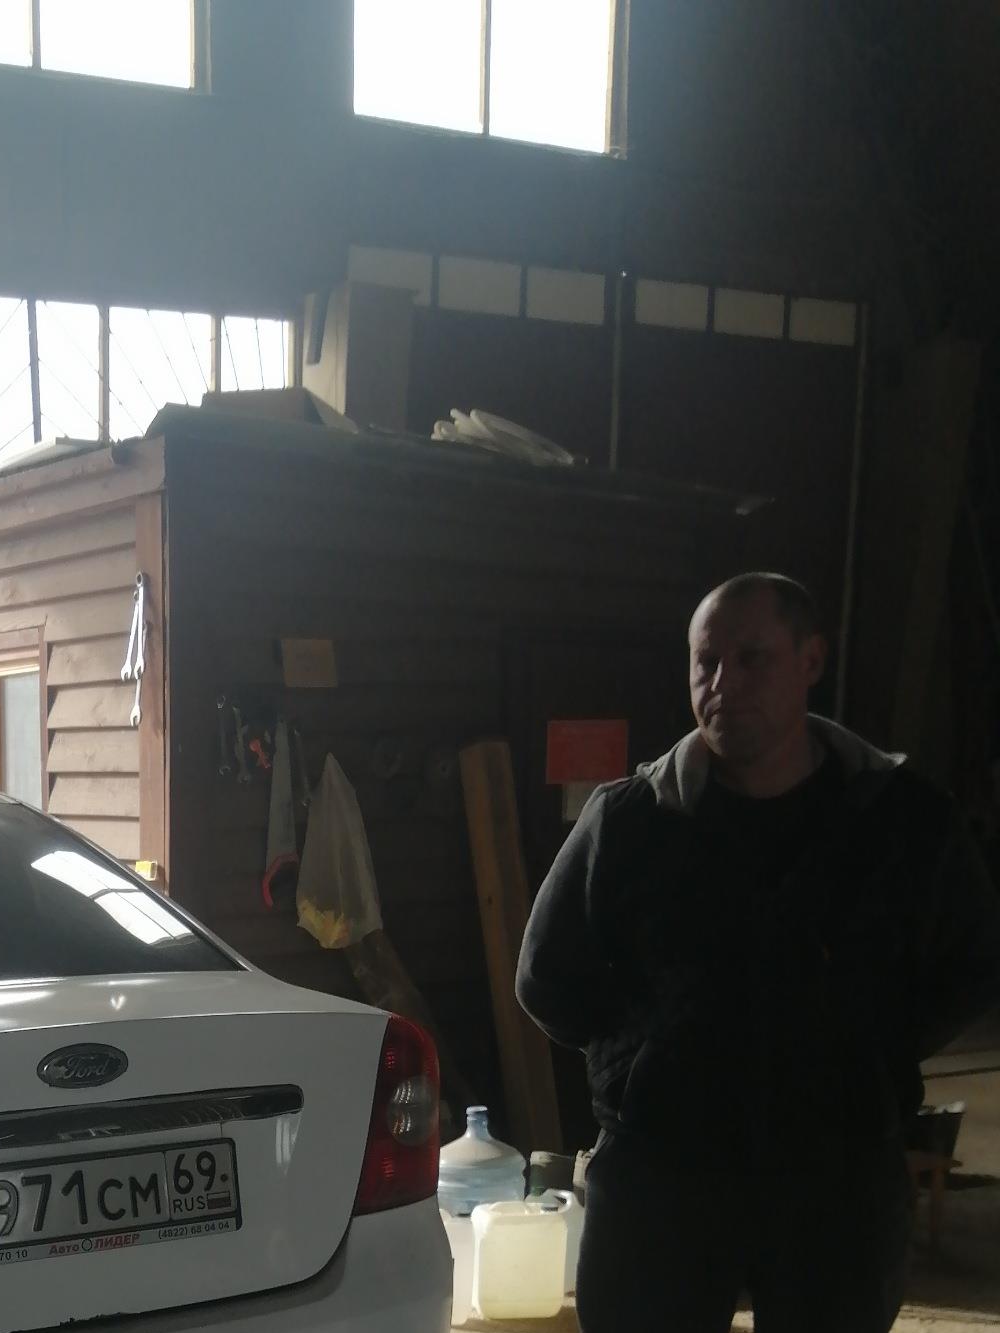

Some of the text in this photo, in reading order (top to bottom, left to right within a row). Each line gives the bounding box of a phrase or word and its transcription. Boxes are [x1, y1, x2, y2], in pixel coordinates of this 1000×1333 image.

[173, 1150, 217, 1195] 69
[173, 1193, 206, 1213] RUS
[0, 1251, 12, 1261] 70
[16, 1249, 28, 1259] 10
